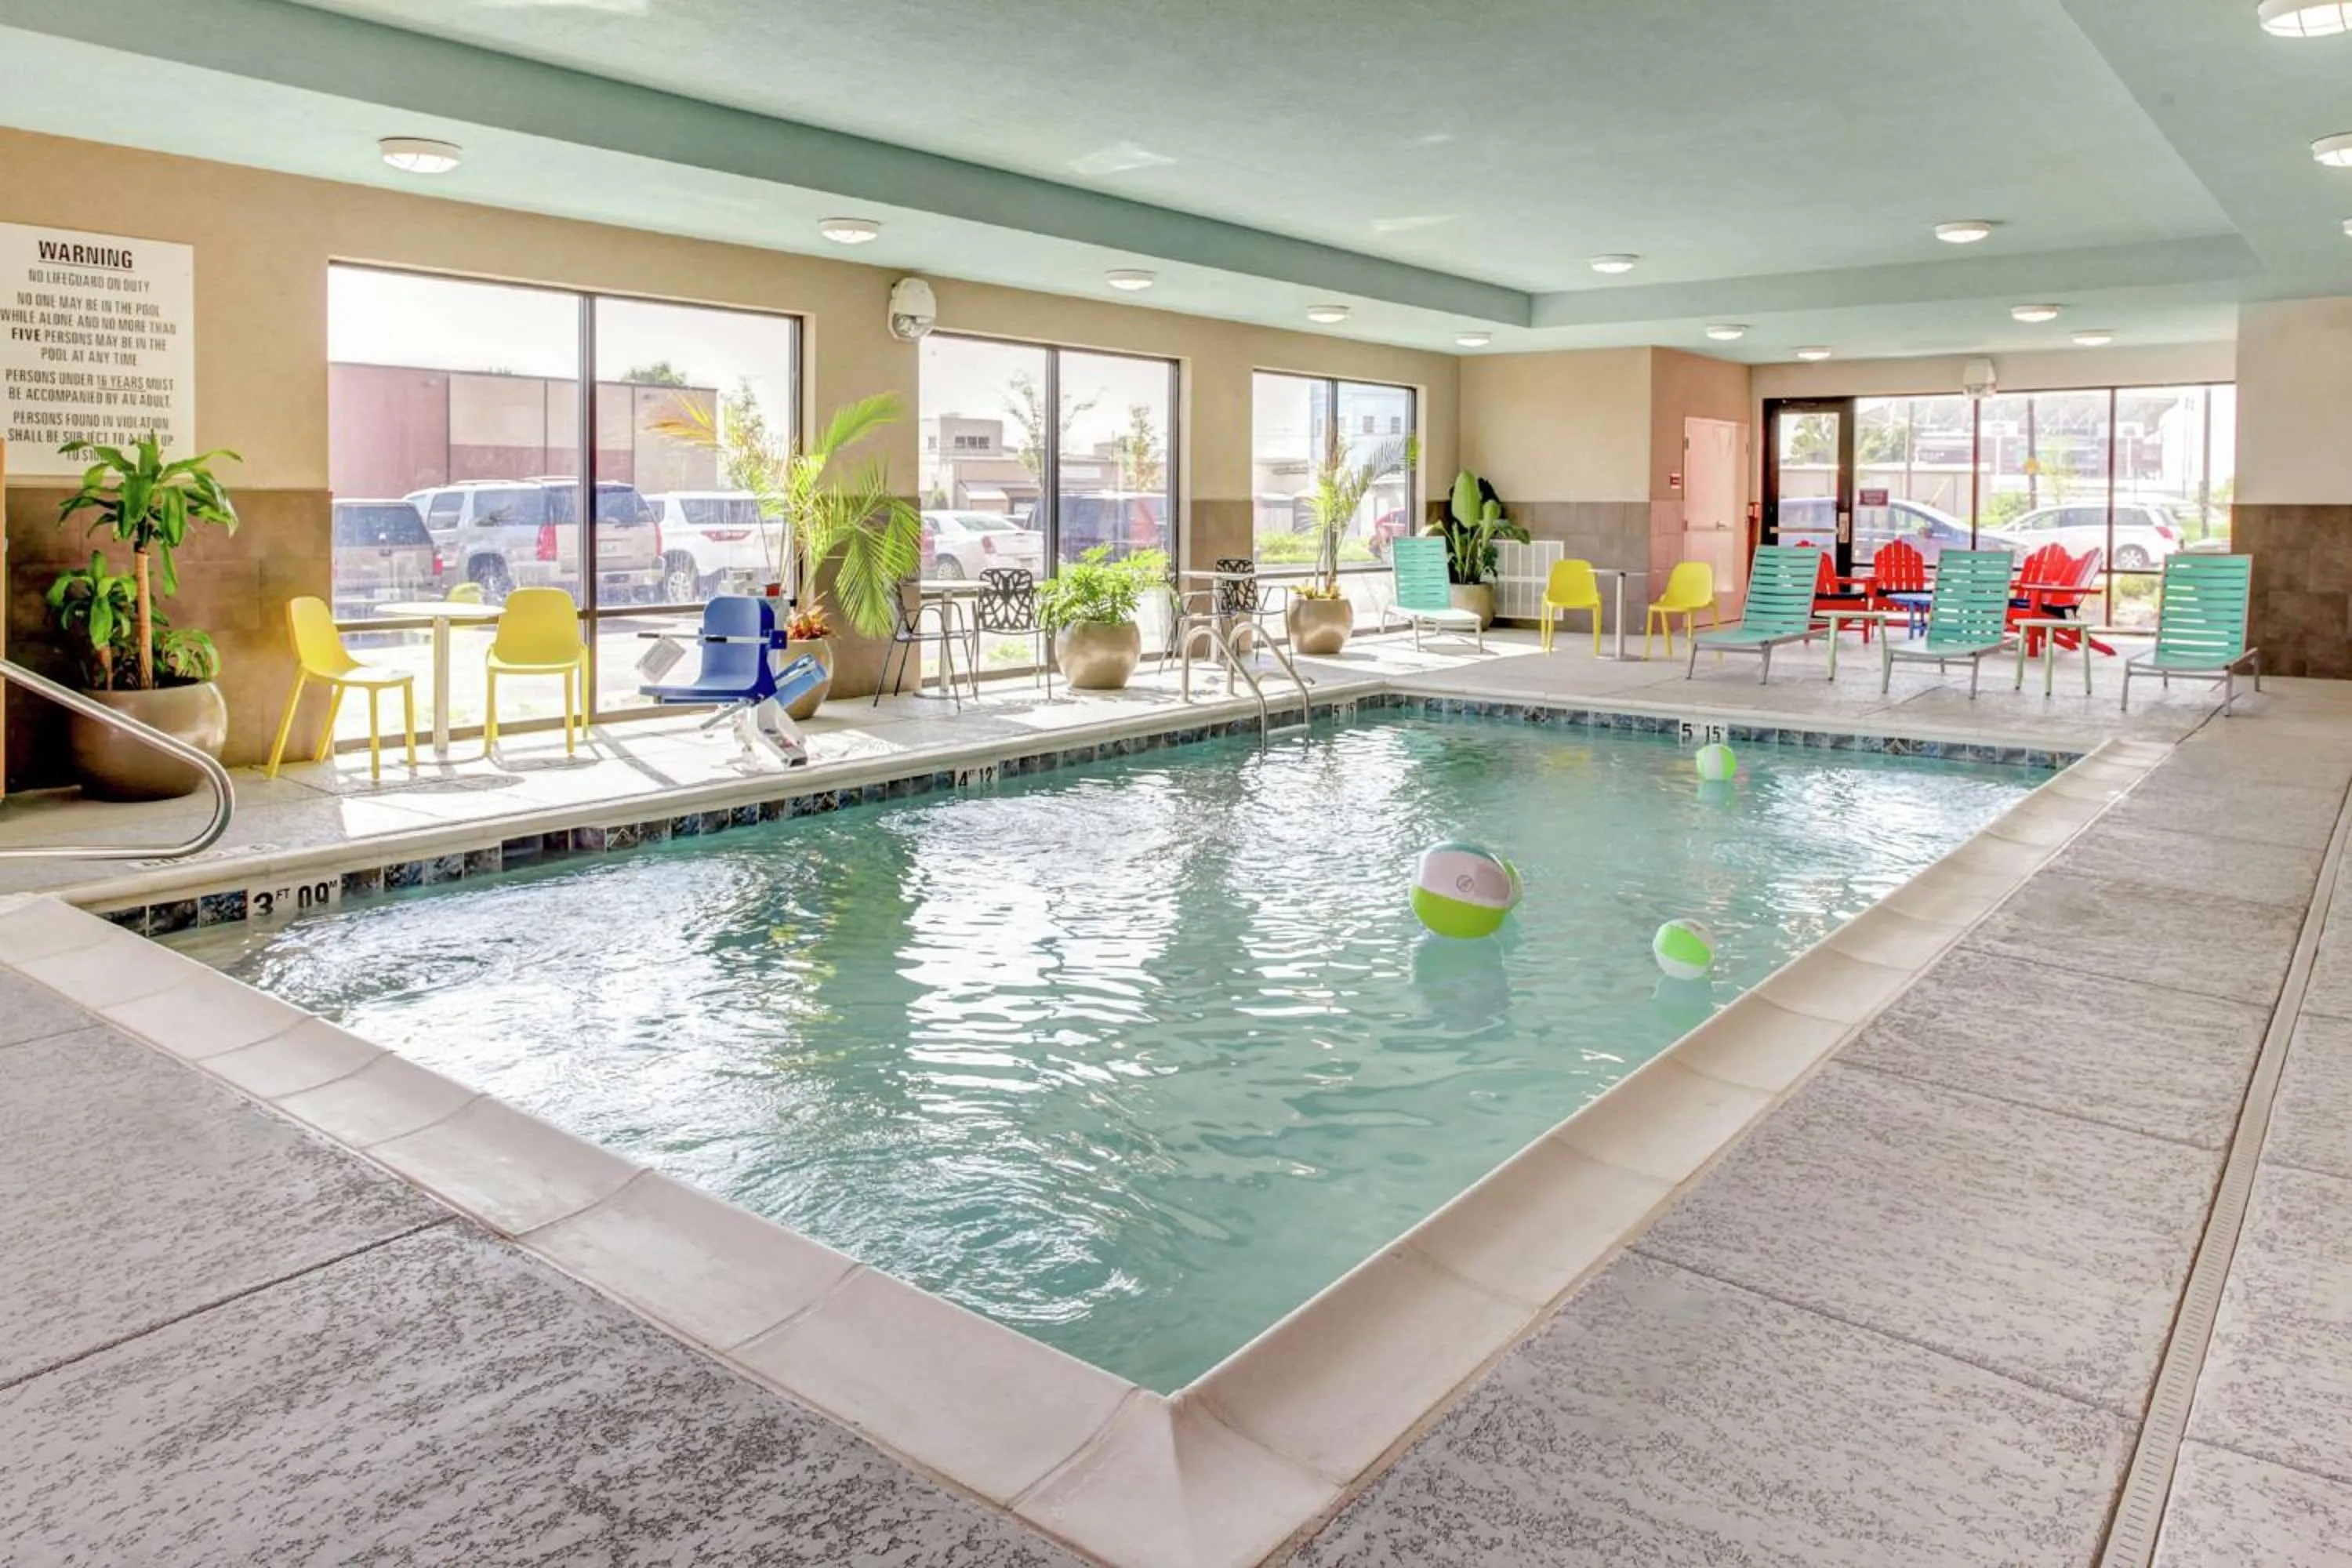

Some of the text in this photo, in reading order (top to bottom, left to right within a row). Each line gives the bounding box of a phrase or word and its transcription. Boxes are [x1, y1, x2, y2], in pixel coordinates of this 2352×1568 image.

[38, 240, 132, 268] WARNING
[28, 269, 150, 292] NO LIFEGUARD ON DUTY
[17, 291, 159, 317] NO ONE MAY BE IN THE POOL
[0, 308, 176, 336] WHILE ALONE AND NO MORE THAN
[12, 327, 166, 351] FIVE PERSONS MAY BE IN THE
[41, 347, 136, 366] POOL AT ANY TIME
[5, 368, 56, 383] PERSONS
[59, 372, 93, 386] UNDER
[111, 375, 144, 390] YEARS
[146, 376, 173, 390] MUST
[9, 387, 21, 400] BE
[26, 388, 103, 404] ACCOMPANIED
[105, 392, 118, 405] BY
[122, 393, 136, 405] AN
[13, 410, 169, 430] PERSONS FOUND IN VIOLATION
[8, 427, 42, 442] SHALL
[46, 430, 58, 443] BE
[113, 432, 125, 445] TO
[161, 434, 174, 447] UP
